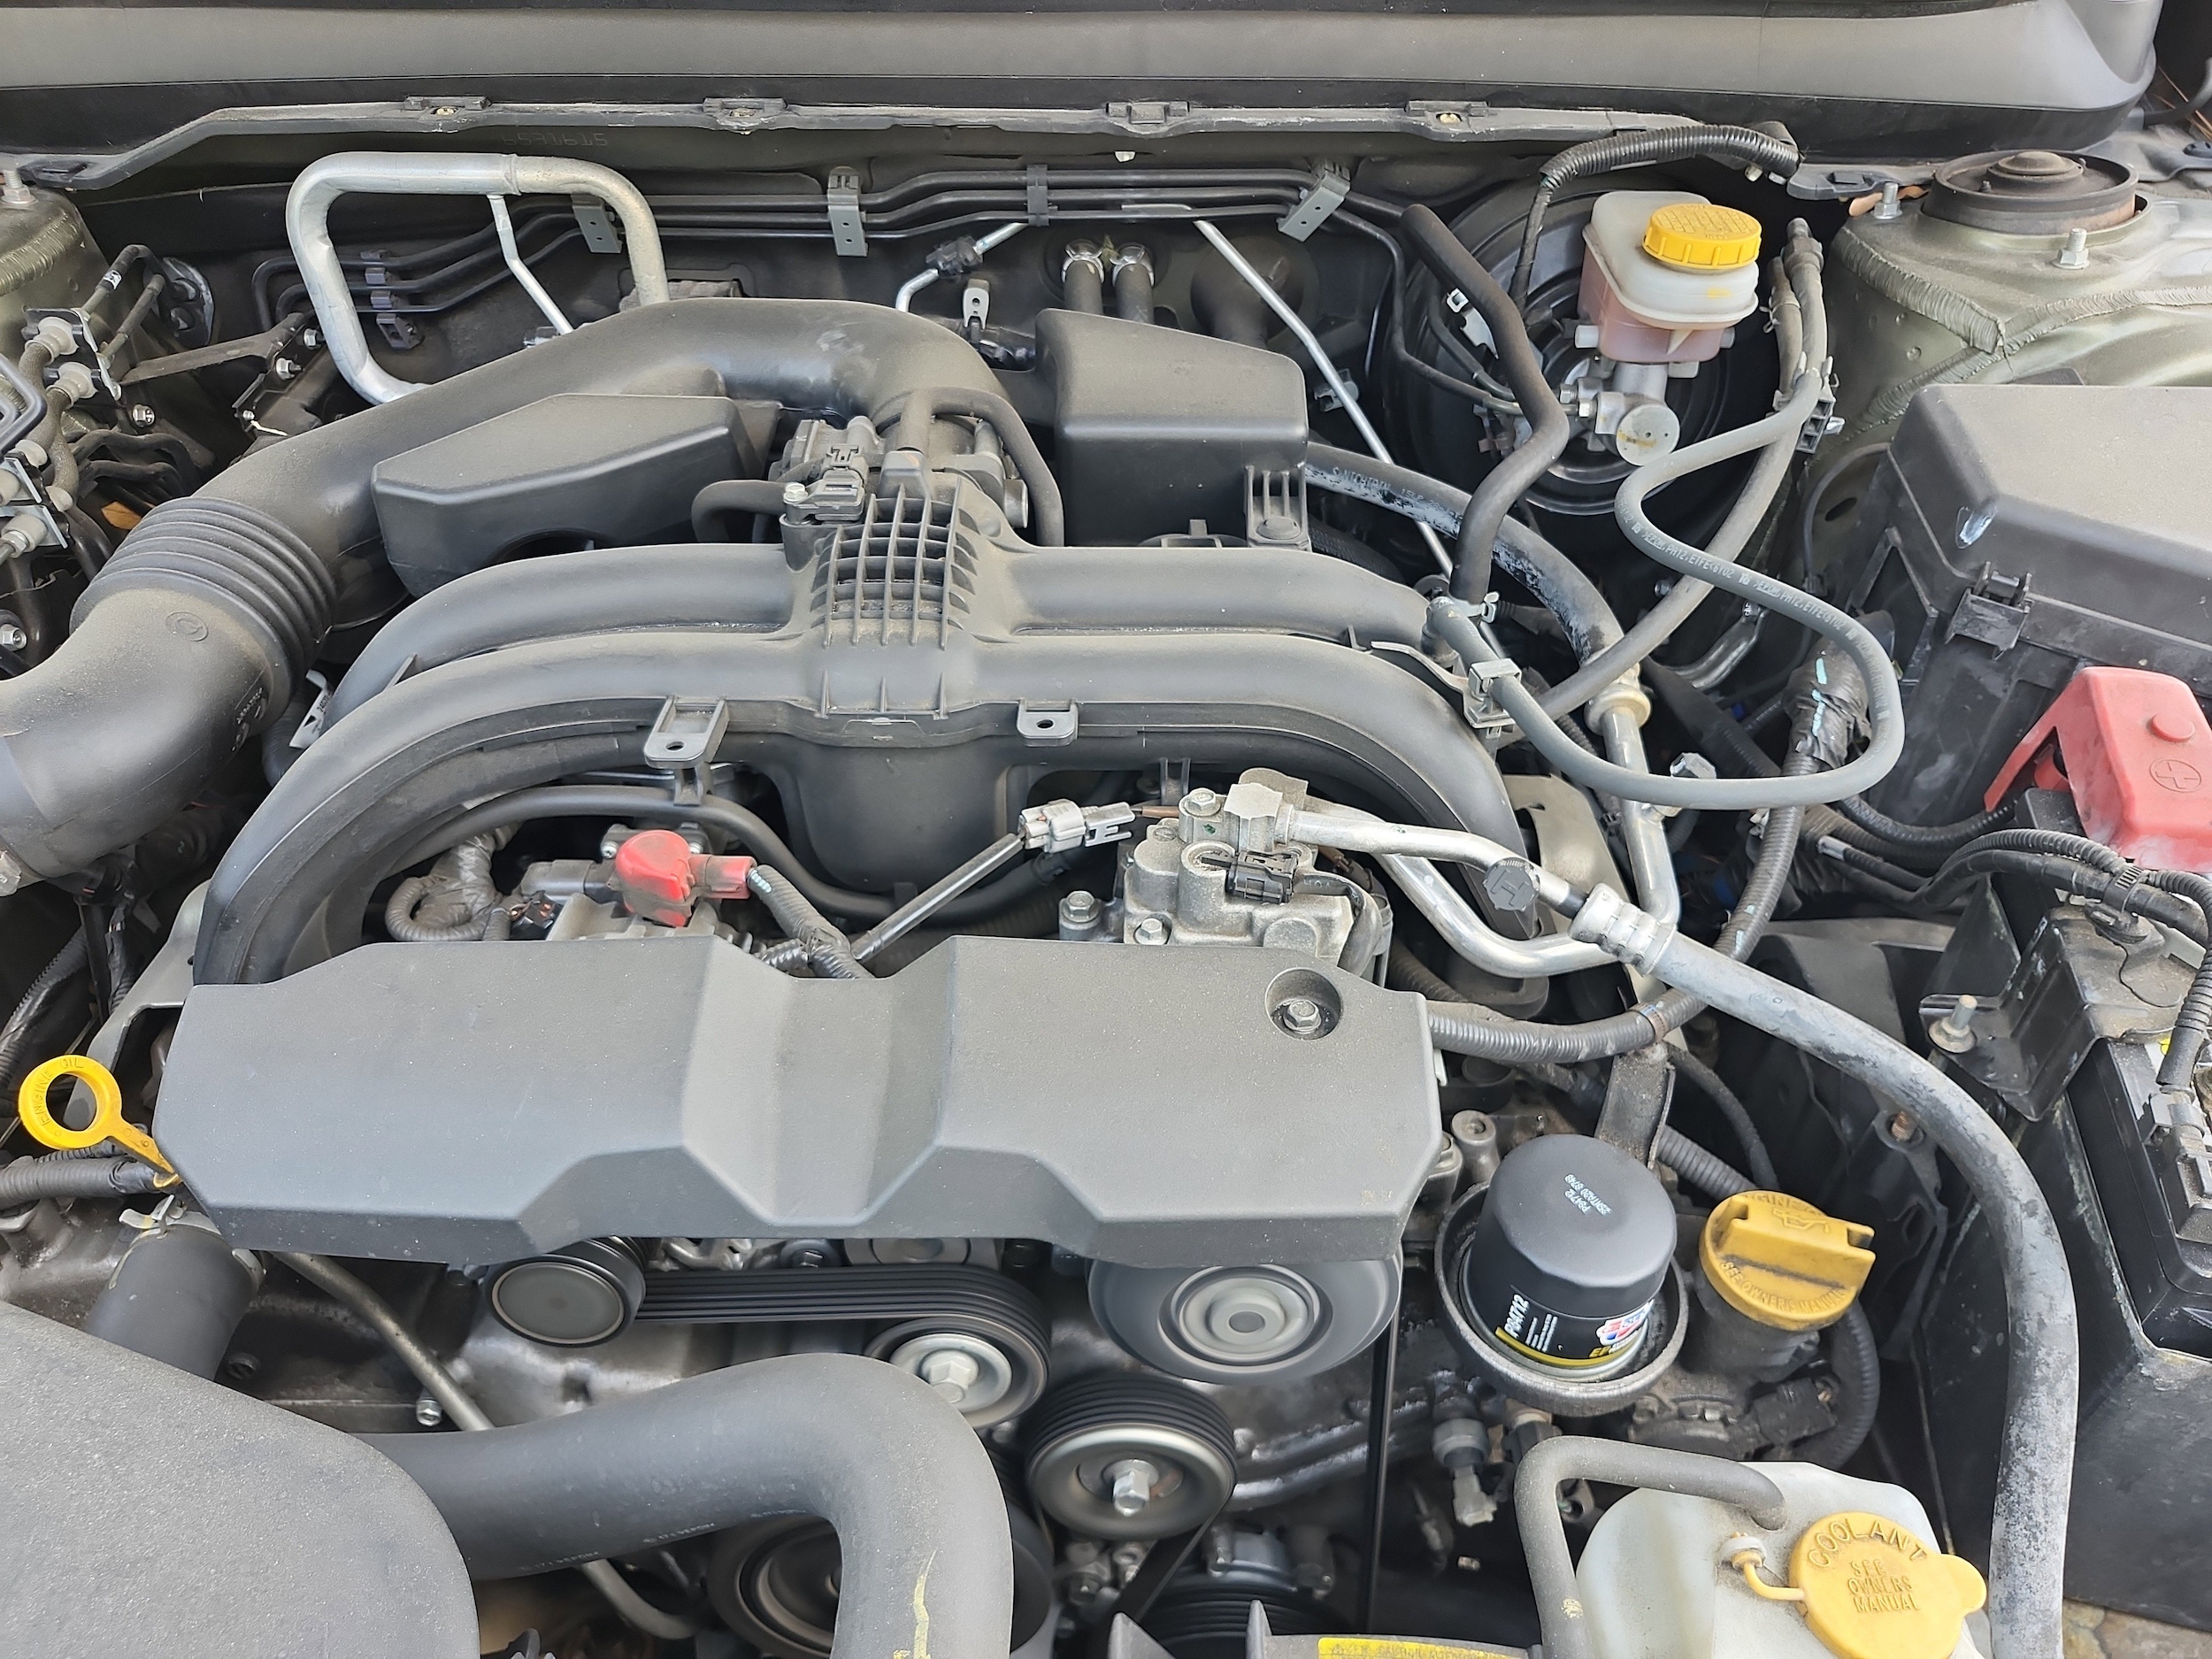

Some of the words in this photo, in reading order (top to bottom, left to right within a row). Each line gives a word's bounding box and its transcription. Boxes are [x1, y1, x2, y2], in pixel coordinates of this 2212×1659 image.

[31, 1067, 54, 1126] ENGINE
[59, 1056, 85, 1070] OIL
[1720, 1261, 1744, 1284] SEE
[1798, 1289, 1847, 1314] MANUAL
[1808, 1517, 1929, 1568] COOLANT
[1847, 1574, 1913, 1596] OWNERS
[1848, 1558, 1888, 1578] SEE
[1854, 1594, 1921, 1613] MANUAL
